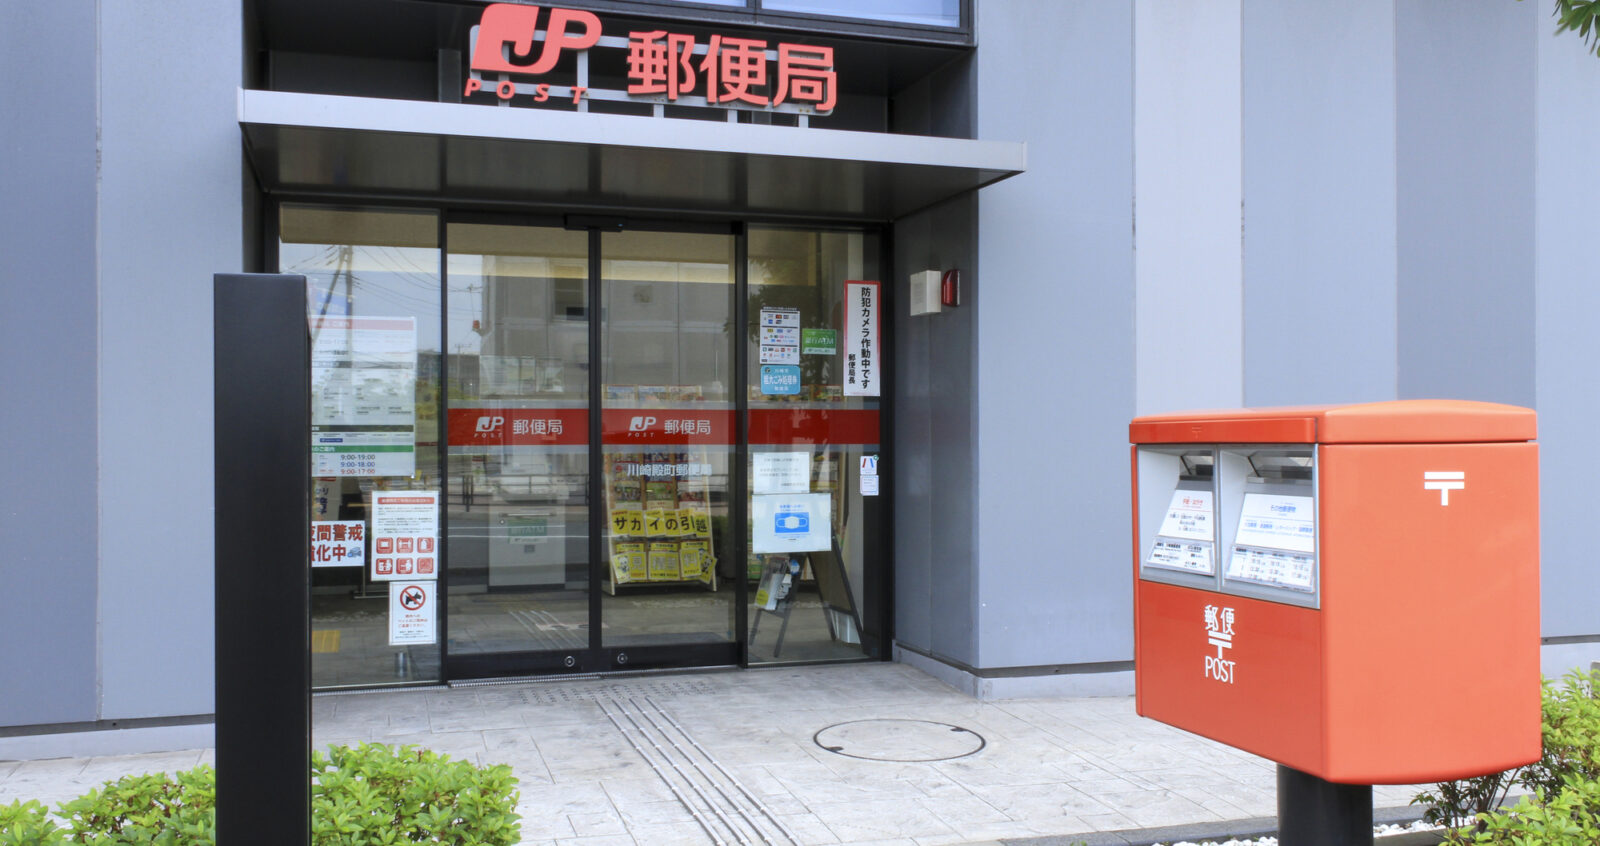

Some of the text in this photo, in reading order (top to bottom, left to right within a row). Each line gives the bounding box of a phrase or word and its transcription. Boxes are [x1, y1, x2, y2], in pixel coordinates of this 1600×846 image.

[472, 3, 838, 112] JP 郵便局
[464, 78, 587, 104] POST
[861, 287, 871, 389] 防犯カメラ作動中です
[475, 416, 563, 435] JP 郵便局
[629, 416, 711, 435] JP 郵便局
[614, 516, 708, 533] サカイの引越
[1204, 604, 1236, 636] 郵便
[1205, 656, 1236, 684] POST
